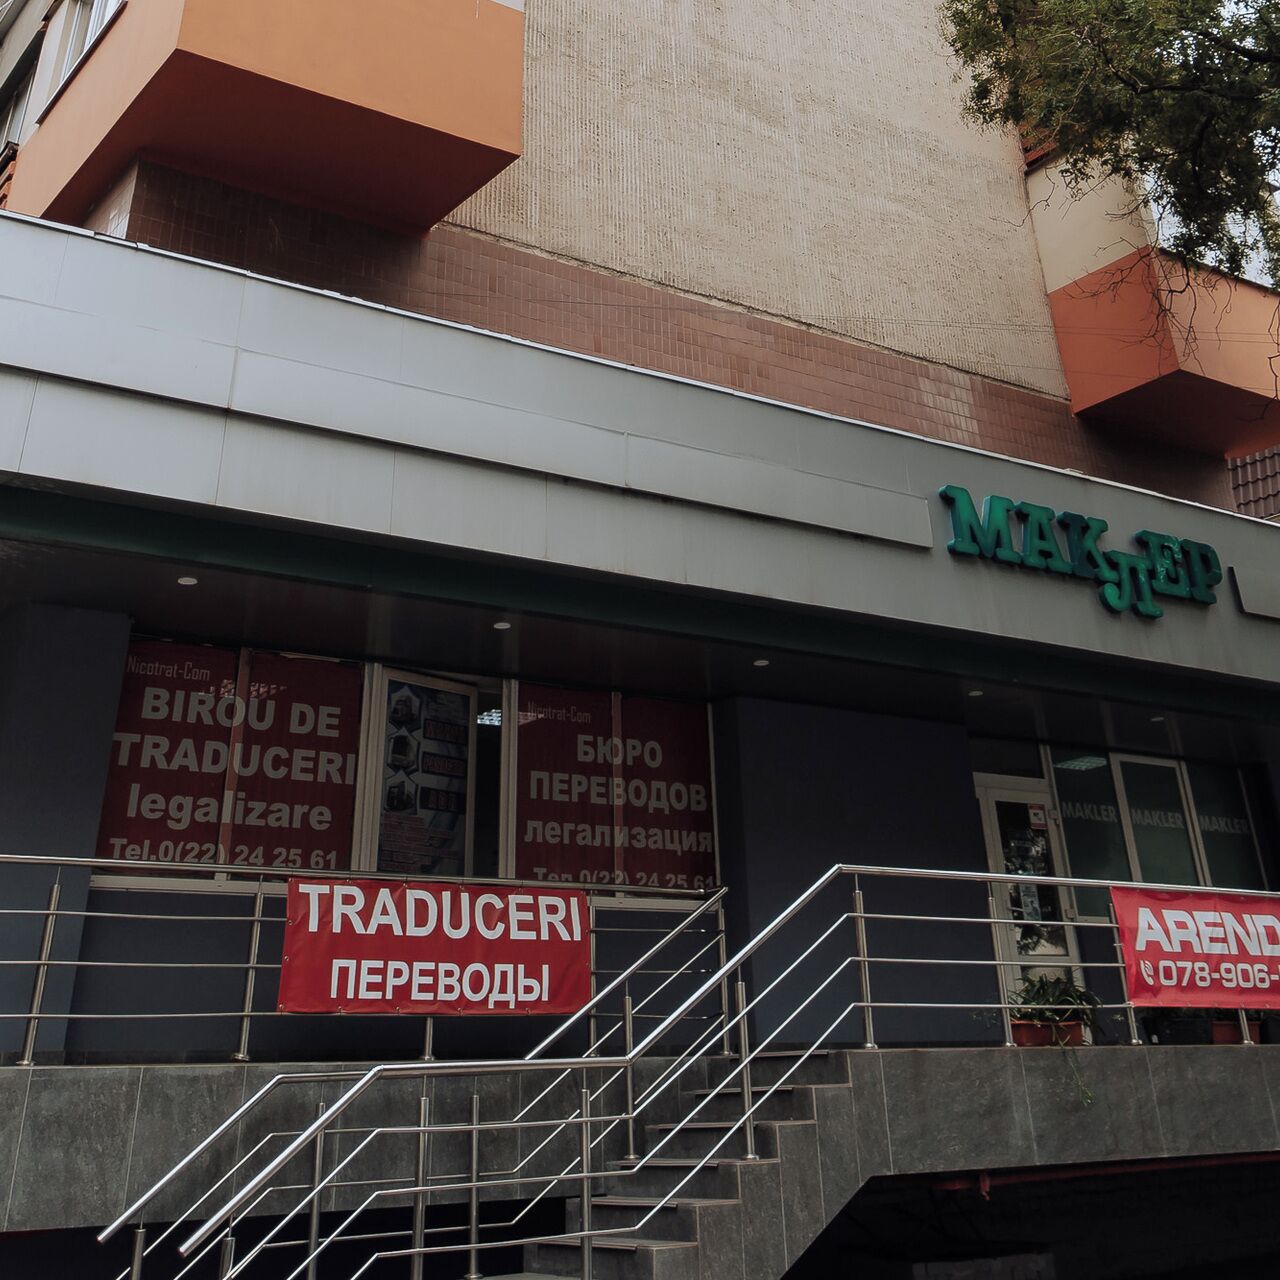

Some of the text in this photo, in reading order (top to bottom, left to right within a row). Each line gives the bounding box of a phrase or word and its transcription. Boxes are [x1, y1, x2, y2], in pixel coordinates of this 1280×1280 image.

[939, 484, 1223, 618] МАКЛЕР
[127, 656, 211, 682] Nicotrat-Com
[141, 686, 341, 738] BIROU DE
[113, 732, 356, 785] TRADUCERI
[577, 734, 663, 768] БЮРО
[127, 783, 332, 830] legalizare
[530, 770, 707, 815] ПЕРЕВОДОВ
[1061, 801, 1118, 822] MAKLER
[1132, 808, 1184, 829] MAKLER
[1199, 816, 1249, 833] MAKLER
[109, 838, 337, 869] Tel.0(22) 24 25 61
[524, 820, 713, 856] легализация
[533, 867, 630, 885] Тел0(22)
[636, 872, 659, 887] 24
[665, 874, 687, 889] 25
[298, 883, 581, 940] TRADUCERI
[330, 959, 549, 1009] ПЕРЕВОДЫ
